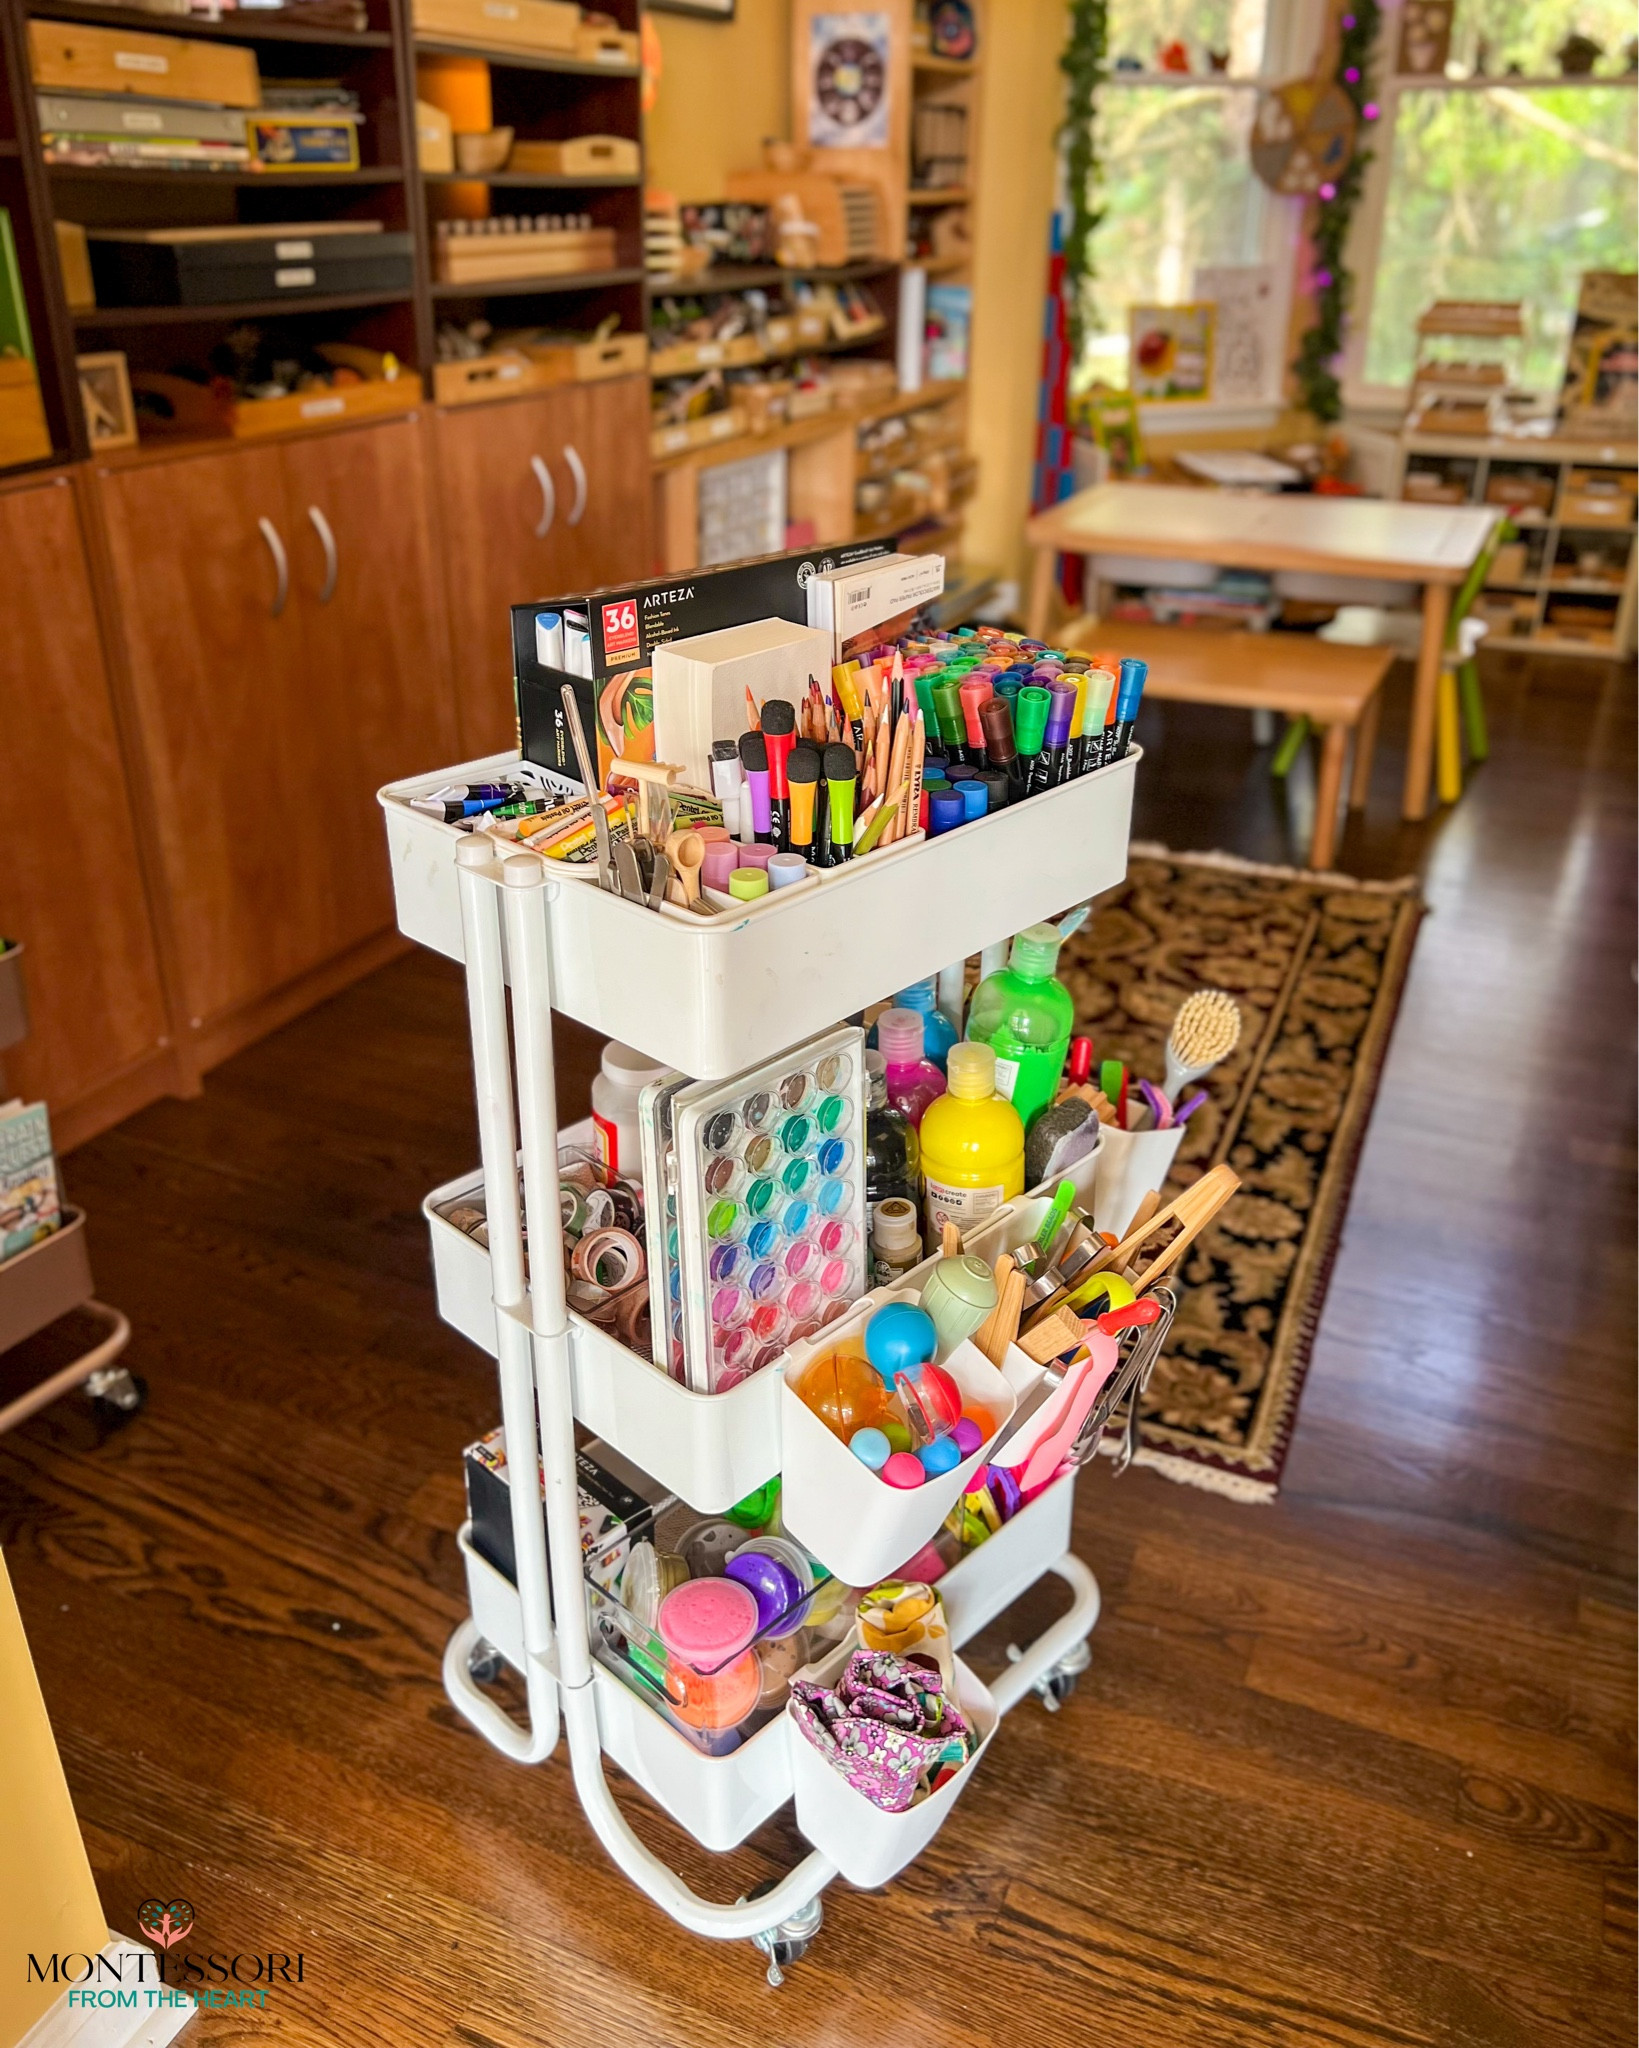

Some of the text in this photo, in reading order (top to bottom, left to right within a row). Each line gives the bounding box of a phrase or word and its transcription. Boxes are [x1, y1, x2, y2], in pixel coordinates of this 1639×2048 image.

[605, 606, 635, 633] 36
[610, 652, 636, 662] PREMIUM
[555, 709, 564, 728] 36
[910, 770, 921, 834] LYRA REMBRA
[575, 1452, 599, 1476] TEZA
